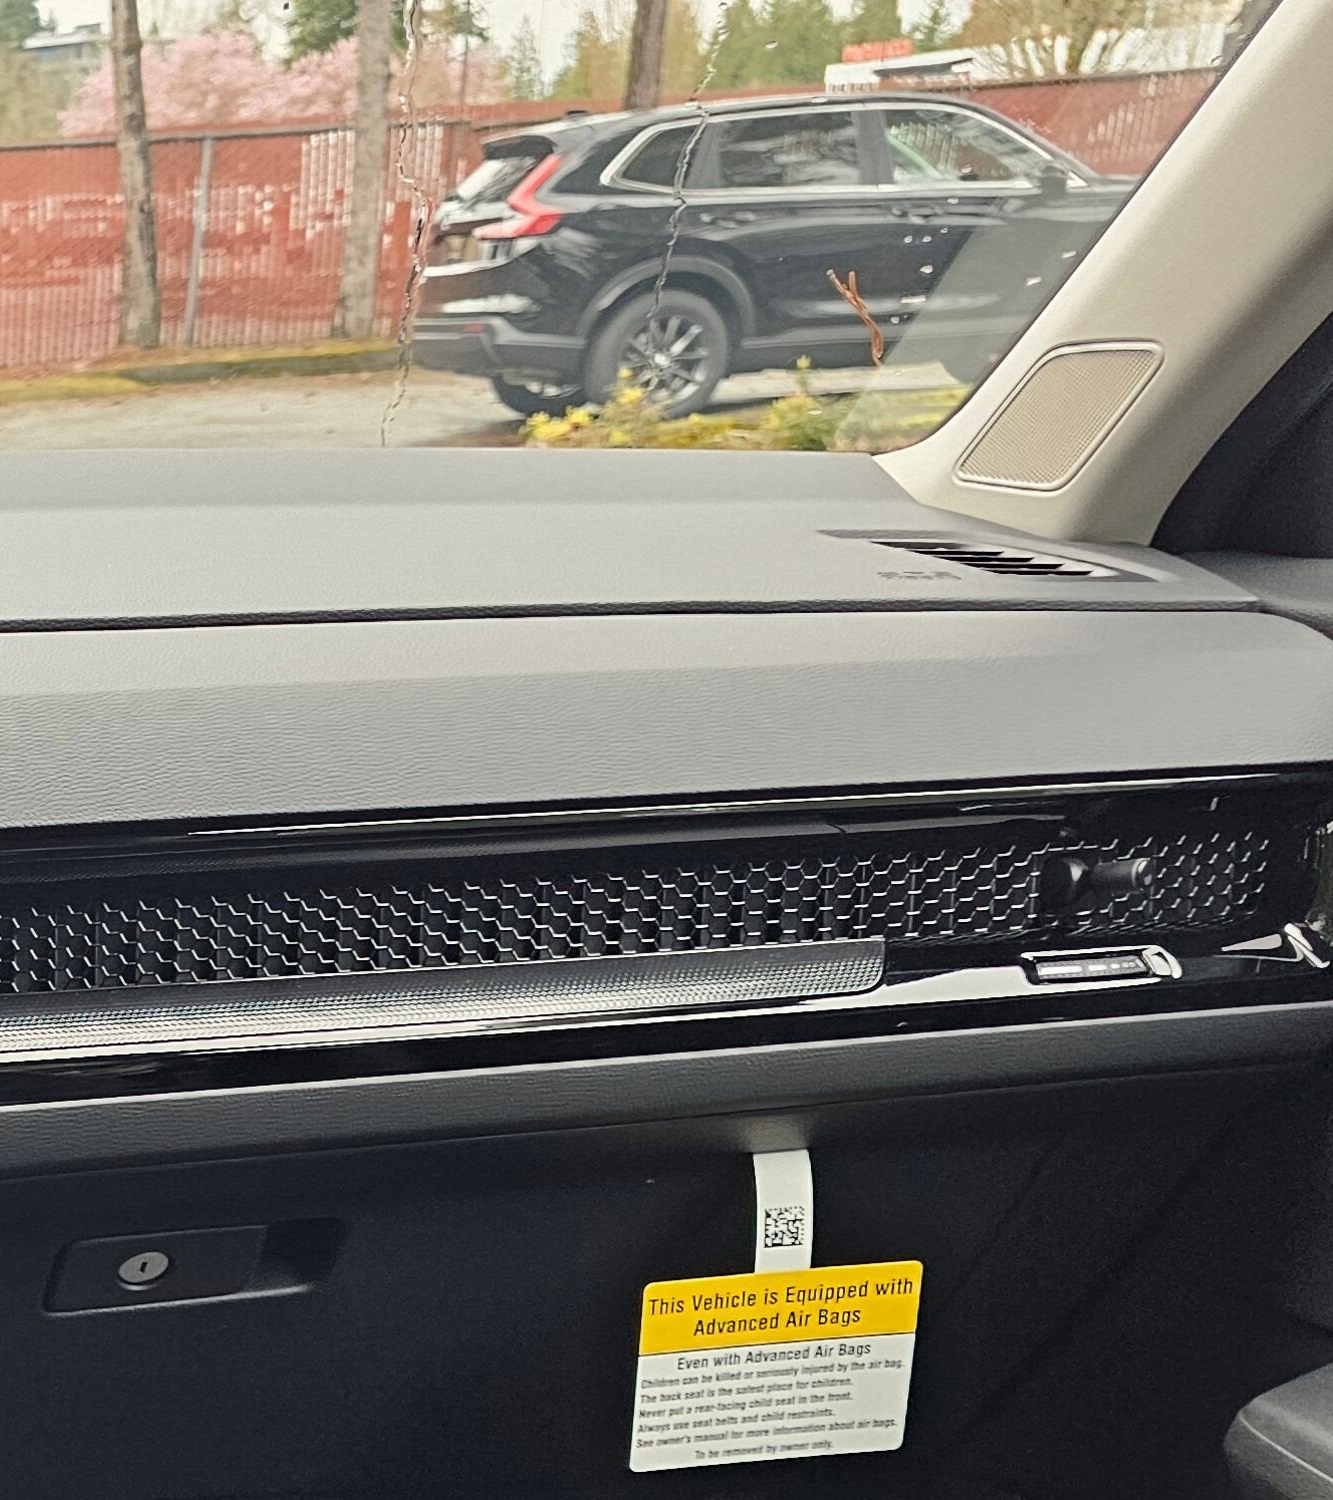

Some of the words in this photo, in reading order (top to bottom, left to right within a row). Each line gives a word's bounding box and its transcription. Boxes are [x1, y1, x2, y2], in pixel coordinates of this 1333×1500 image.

[648, 1297, 685, 1316] This
[692, 1291, 757, 1311] Vehicle
[764, 1288, 779, 1305] is
[785, 1280, 869, 1306] Equipped
[876, 1278, 913, 1296] with
[693, 1312, 780, 1337] Advanced
[786, 1310, 812, 1328] Air
[818, 1308, 861, 1328] Bags
[677, 1357, 708, 1371] Even
[713, 1353, 741, 1367] with
[745, 1346, 810, 1364] Advanced
[814, 1345, 835, 1358] Air
[838, 1343, 872, 1358] Bags
[701, 1375, 713, 1383] be
[716, 1371, 741, 1381] killed
[744, 1371, 754, 1379] or
[837, 1363, 849, 1374] by
[851, 1362, 866, 1371] the
[868, 1360, 882, 1370] air
[640, 1393, 657, 1404] The
[660, 1392, 681, 1402] back
[684, 1389, 705, 1400] seat
[707, 1389, 715, 1397] is
[718, 1387, 733, 1396] the
[766, 1382, 793, 1394] place
[639, 1408, 667, 1419] Never
[669, 1406, 685, 1417] put
[748, 1398, 773, 1409] child
[775, 1396, 796, 1407] seat
[798, 1395, 807, 1404] in
[810, 1394, 825, 1403] the
[636, 1438, 654, 1449] See
[828, 1421, 855, 1432] about
[857, 1420, 871, 1429] air
[637, 1423, 671, 1434] Always
[673, 1421, 690, 1431] use
[693, 1418, 713, 1429] seat
[715, 1416, 739, 1427] belts
[741, 1413, 759, 1424] and
[761, 1411, 785, 1422] child
[695, 1450, 706, 1459] To
[708, 1449, 719, 1458] be
[765, 1445, 777, 1455] by
